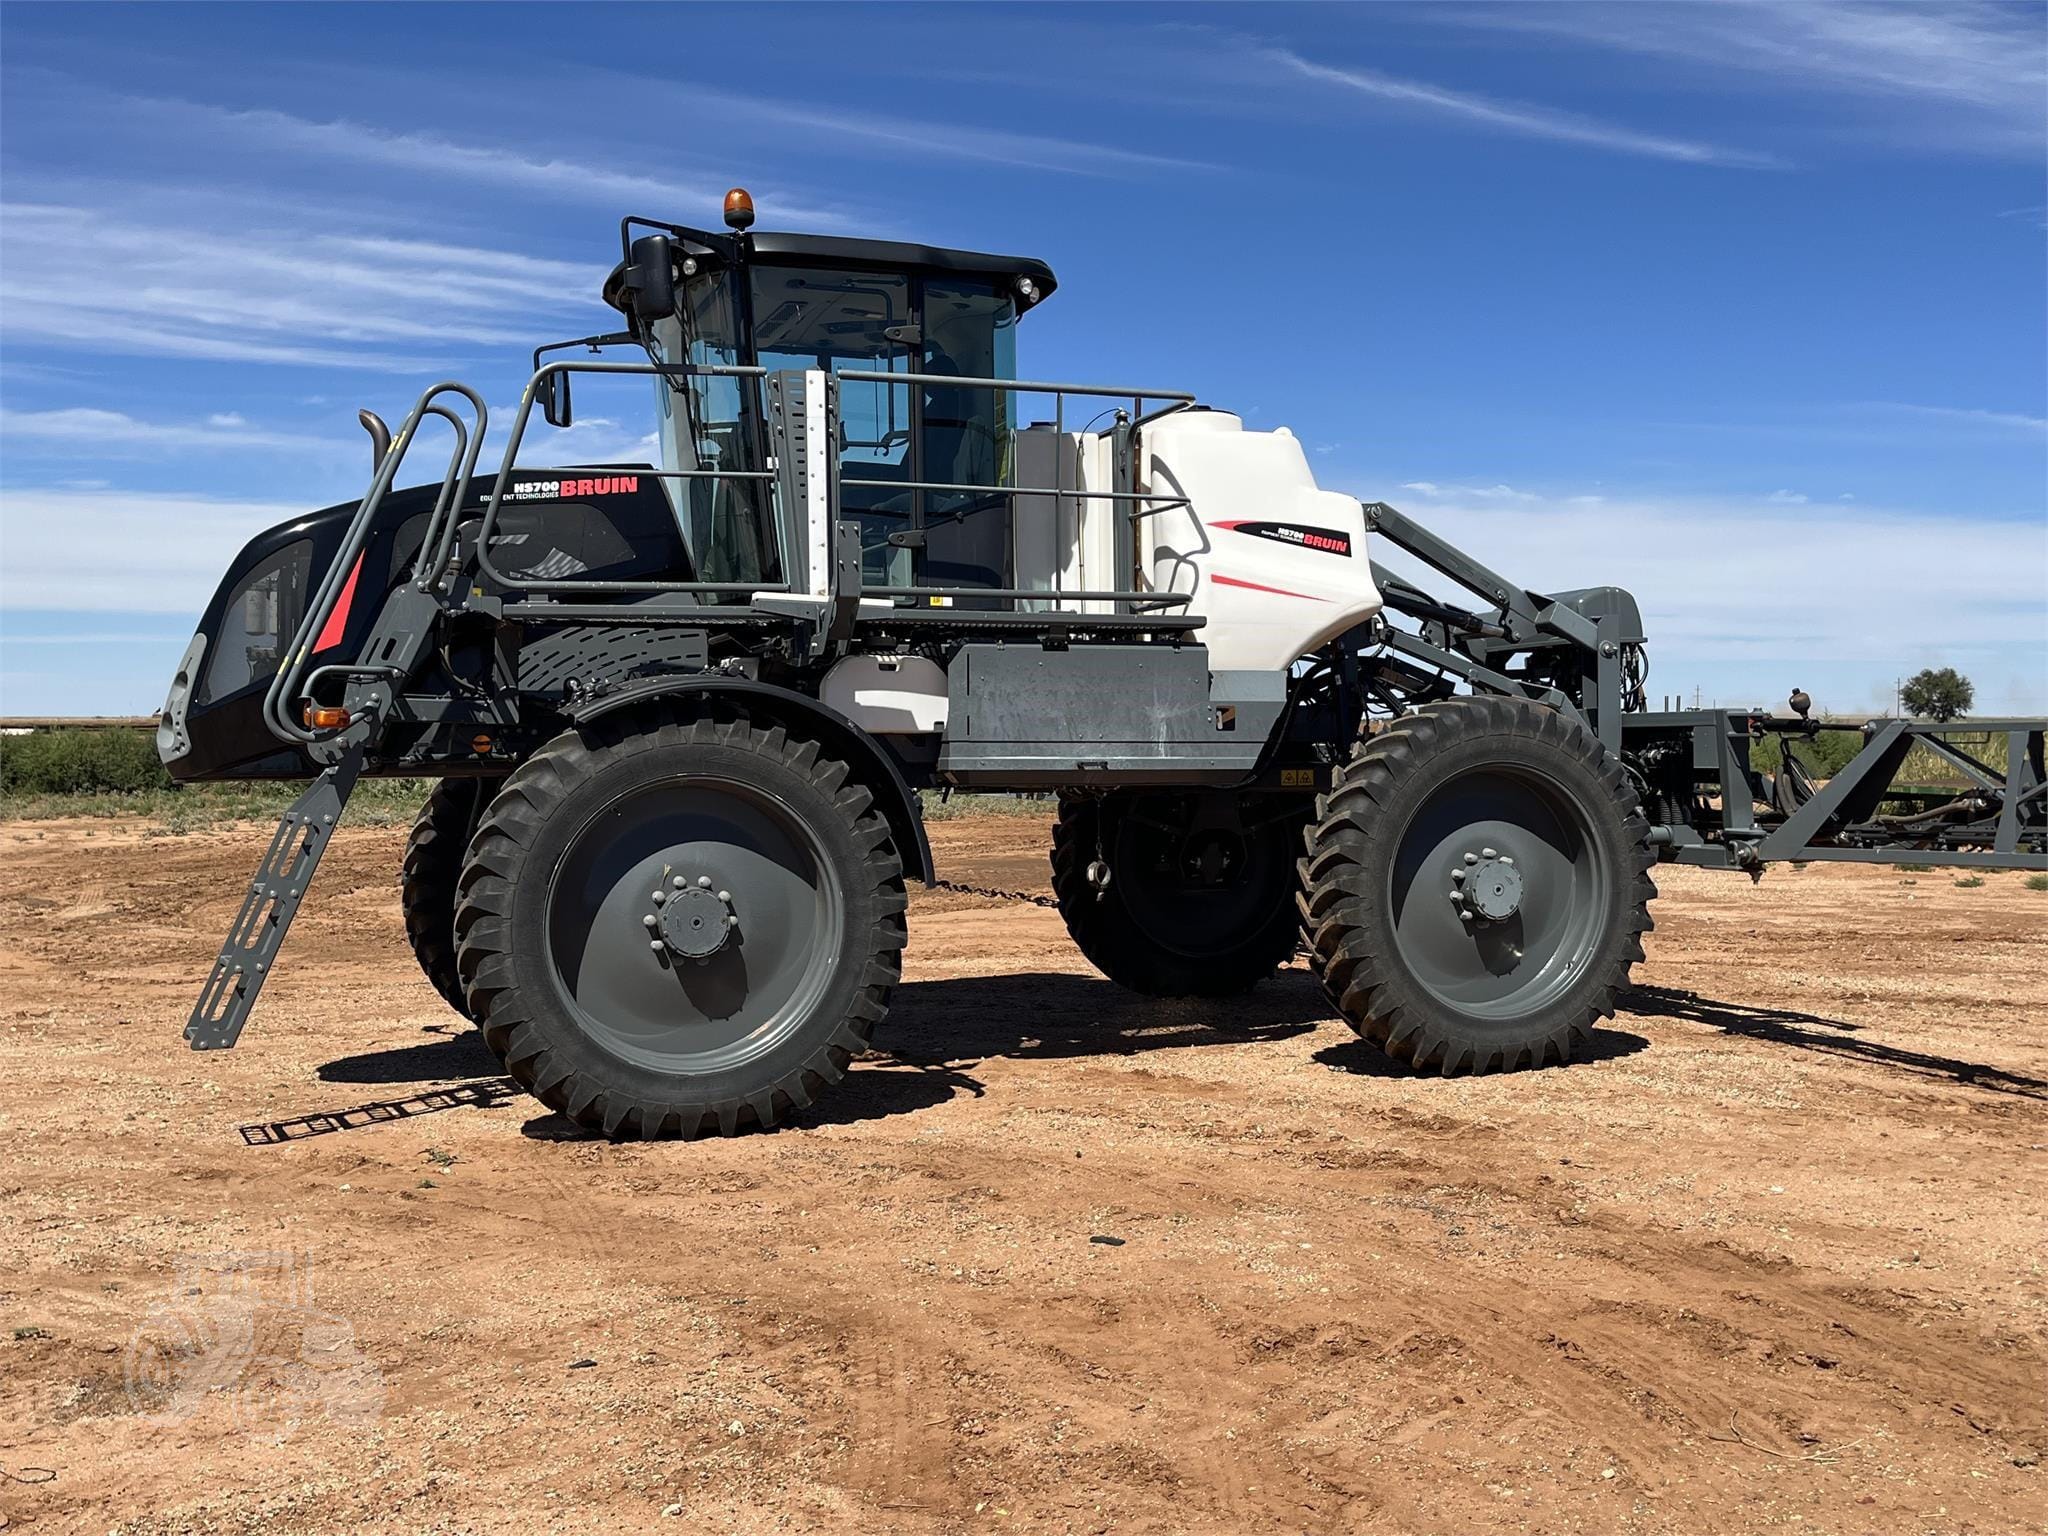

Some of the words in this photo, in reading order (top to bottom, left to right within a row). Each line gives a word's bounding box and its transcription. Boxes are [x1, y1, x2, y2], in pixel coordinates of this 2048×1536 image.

[514, 481, 560, 493] HS700
[560, 477, 638, 497] BRUIN
[480, 494, 515, 502] EQUENT
[1304, 534, 1348, 552] BRUIN
